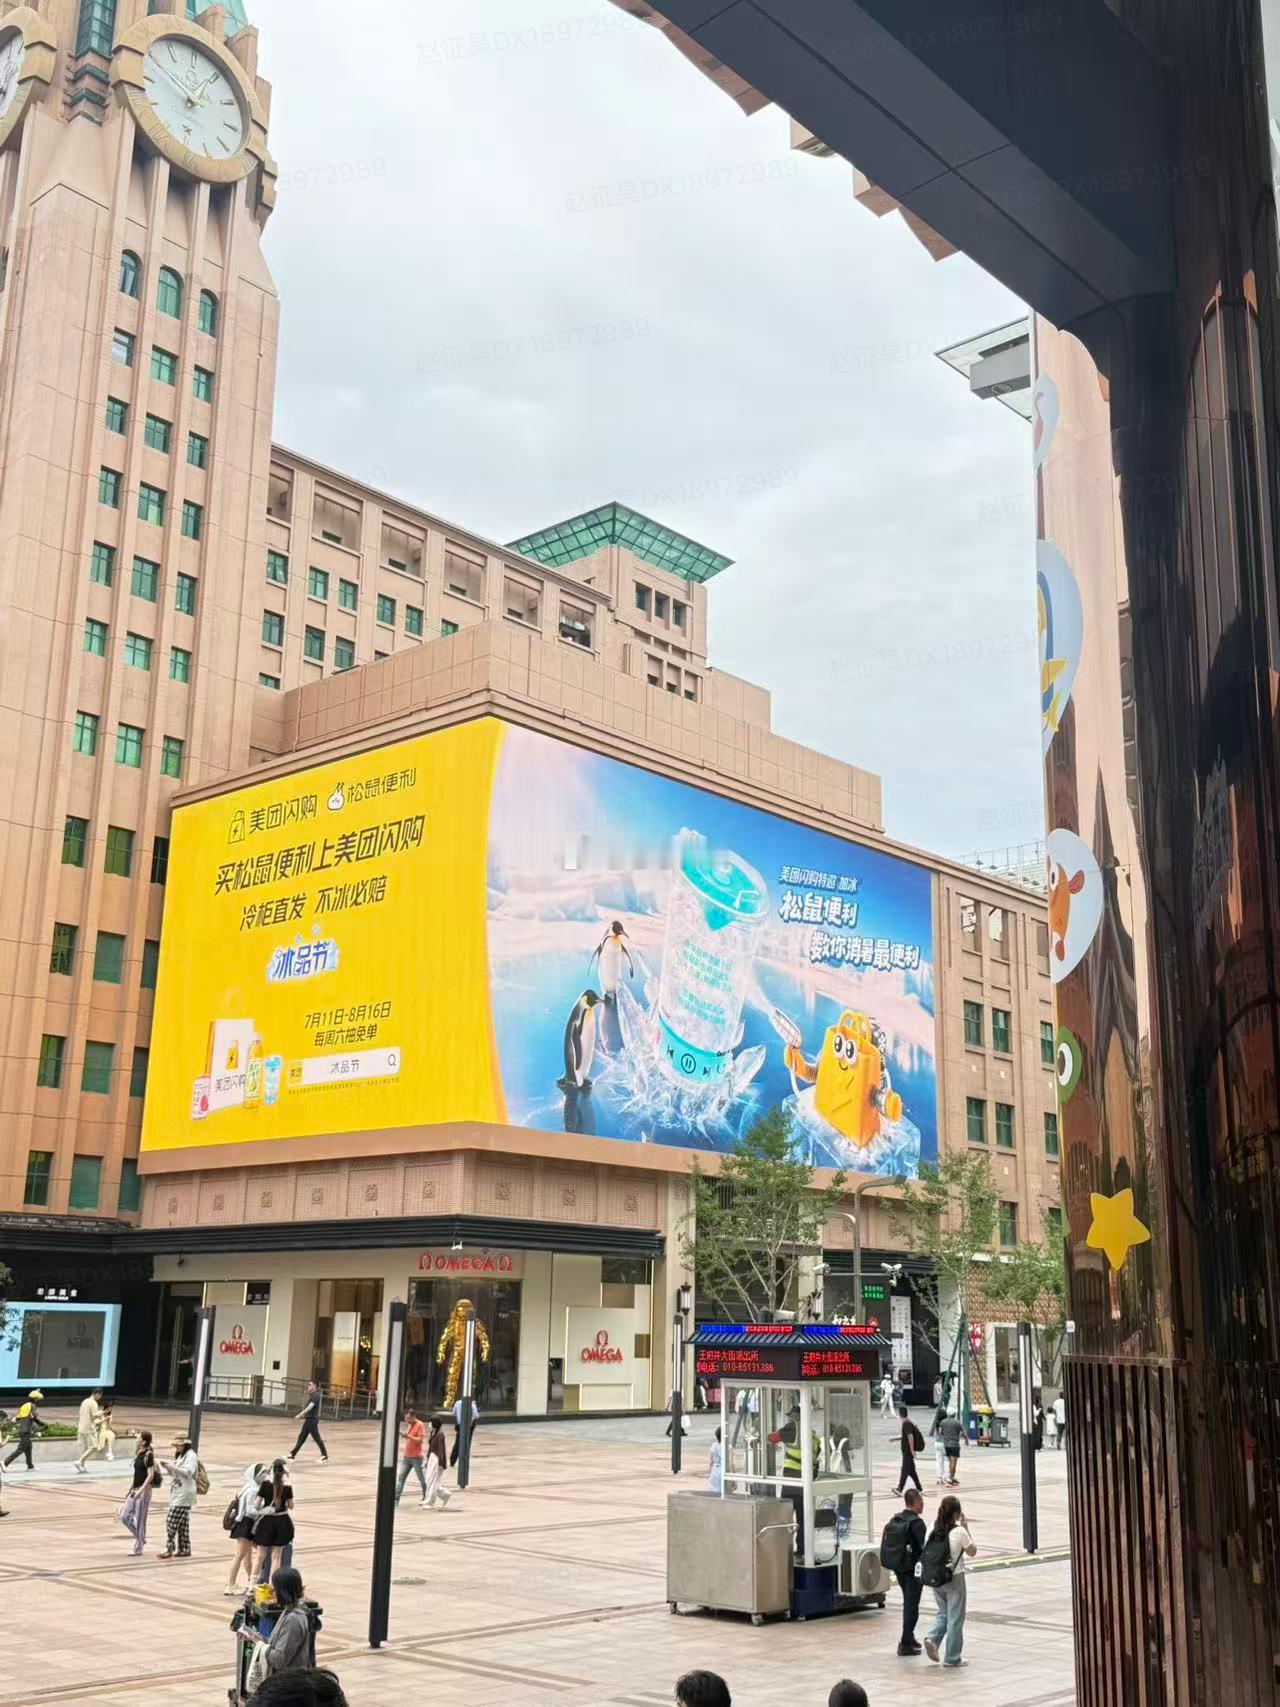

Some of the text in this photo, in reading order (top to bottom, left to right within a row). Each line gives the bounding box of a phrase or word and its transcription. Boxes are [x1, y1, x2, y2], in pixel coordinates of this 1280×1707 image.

[347, 767, 417, 803] 松鼠便利
[249, 793, 318, 835] 美团闪购
[215, 815, 426, 895] 买松鼠便利上美团闪购
[240, 875, 388, 931] 冷柜直发 不冰必赔
[778, 889, 858, 928] 松鼠便利
[272, 941, 330, 979] 冰品节
[809, 929, 920, 971] 数你消暑最便利
[304, 1001, 391, 1029] 7月11日-8月16日
[314, 1023, 378, 1047] 每周六抽免单
[330, 1059, 360, 1074] 冰品节
[435, 1254, 496, 1272] OMEGA
[219, 1340, 255, 1356] OMEGA
[580, 1347, 624, 1365] OMEGA
